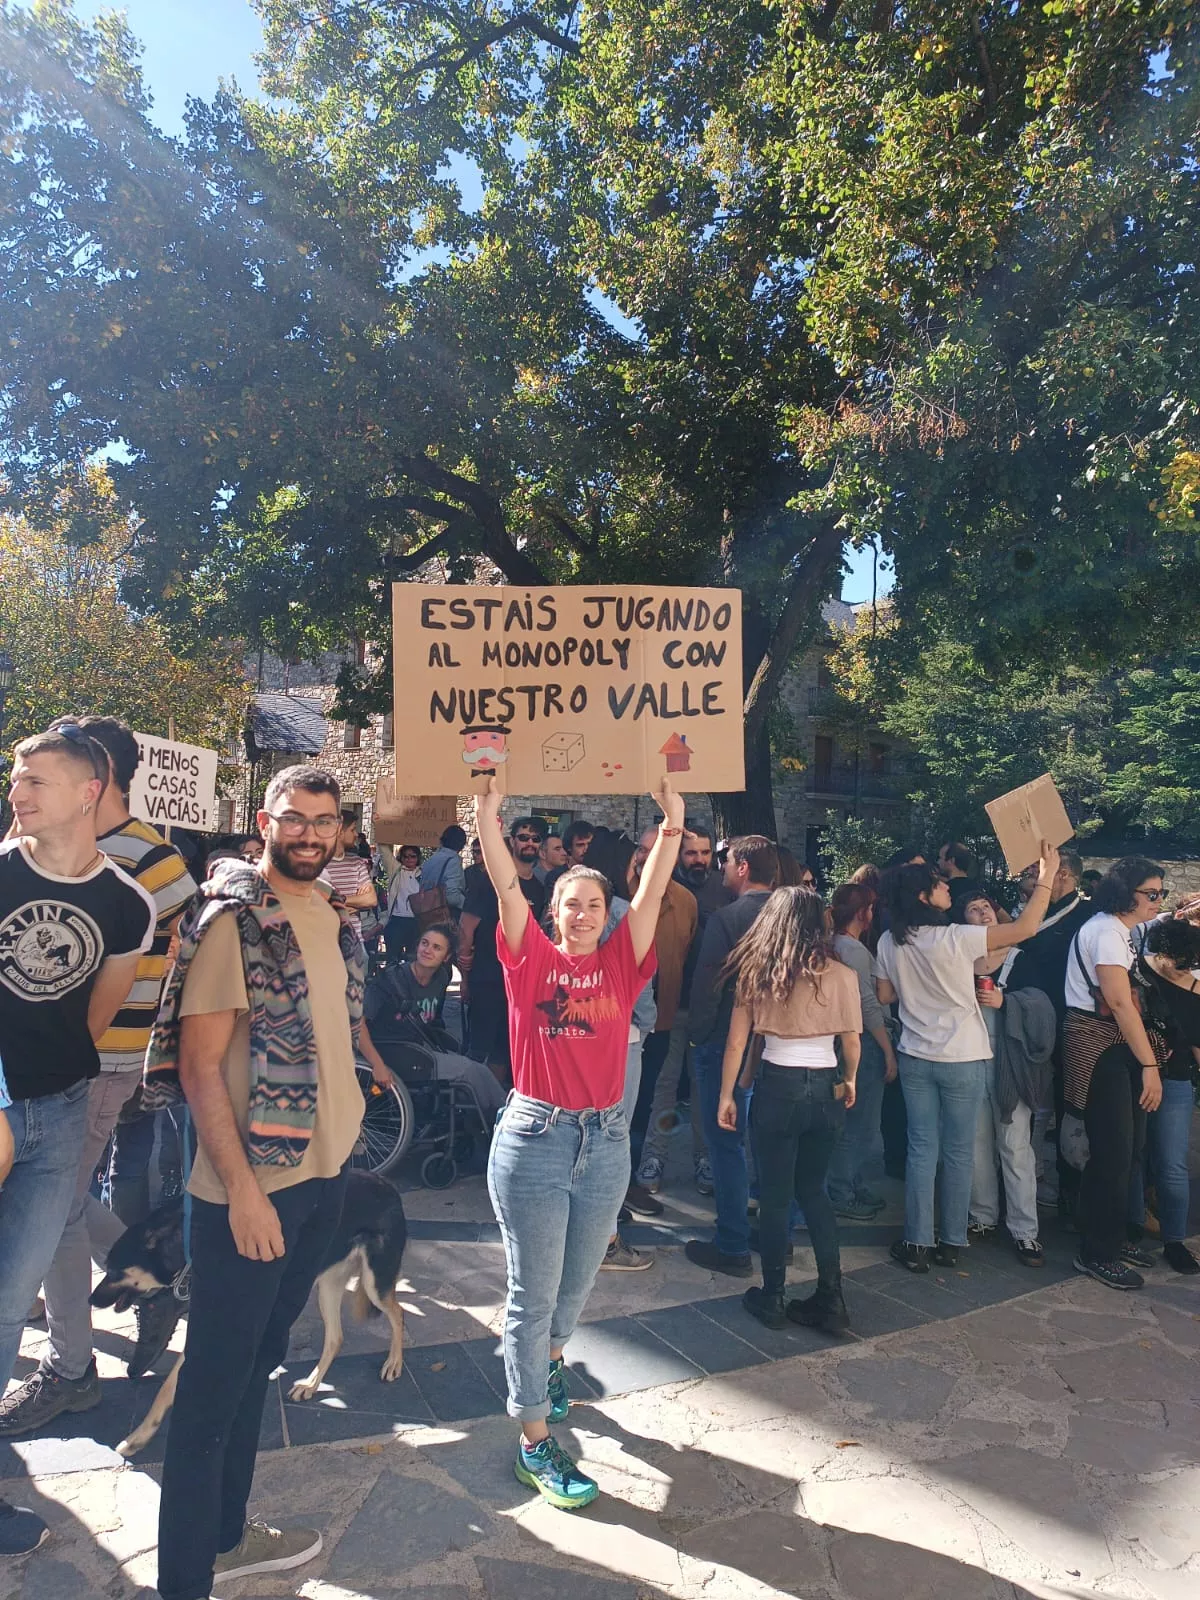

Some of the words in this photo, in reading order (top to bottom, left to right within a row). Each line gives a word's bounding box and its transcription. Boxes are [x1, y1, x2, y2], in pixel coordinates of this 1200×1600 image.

[583, 596, 732, 632] JUGANDO
[428, 642, 461, 667] AL
[482, 637, 631, 670] MONOPOLY
[662, 640, 727, 669] CON
[430, 684, 588, 724] NUESTRO
[608, 681, 726, 720] VALLE
[148, 773, 197, 798] CASAS
